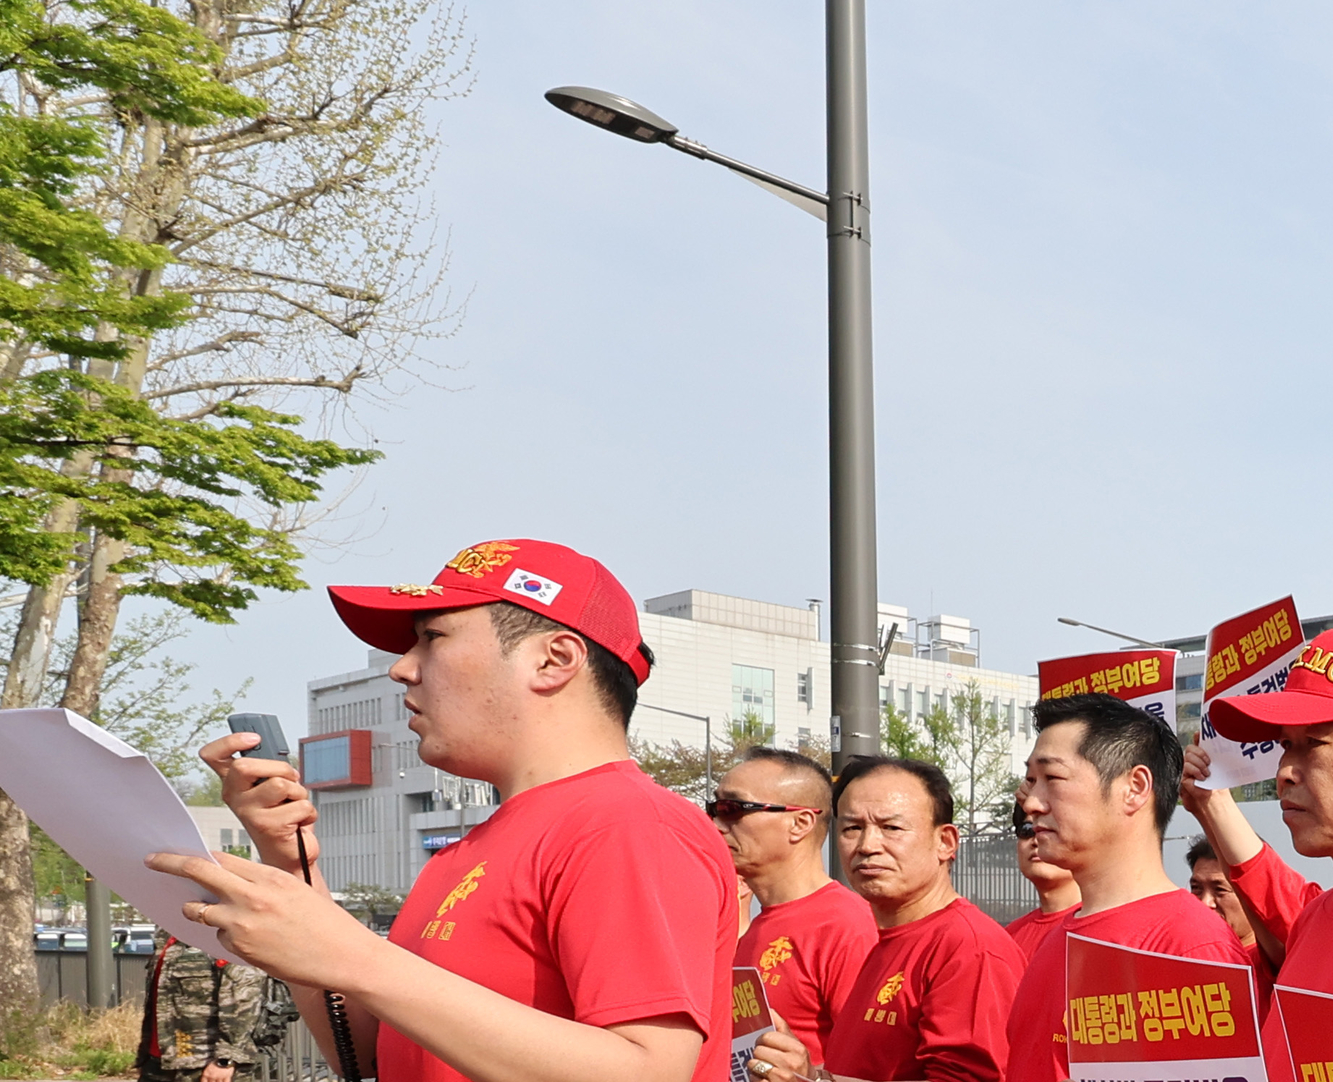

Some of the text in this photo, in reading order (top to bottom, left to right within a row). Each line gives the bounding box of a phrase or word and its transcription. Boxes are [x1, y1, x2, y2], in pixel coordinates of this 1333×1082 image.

[1239, 608, 1292, 665] 정부여당
[1090, 657, 1160, 695] 정부여당
[1069, 982, 1235, 1045] 대통령과 정부여당
